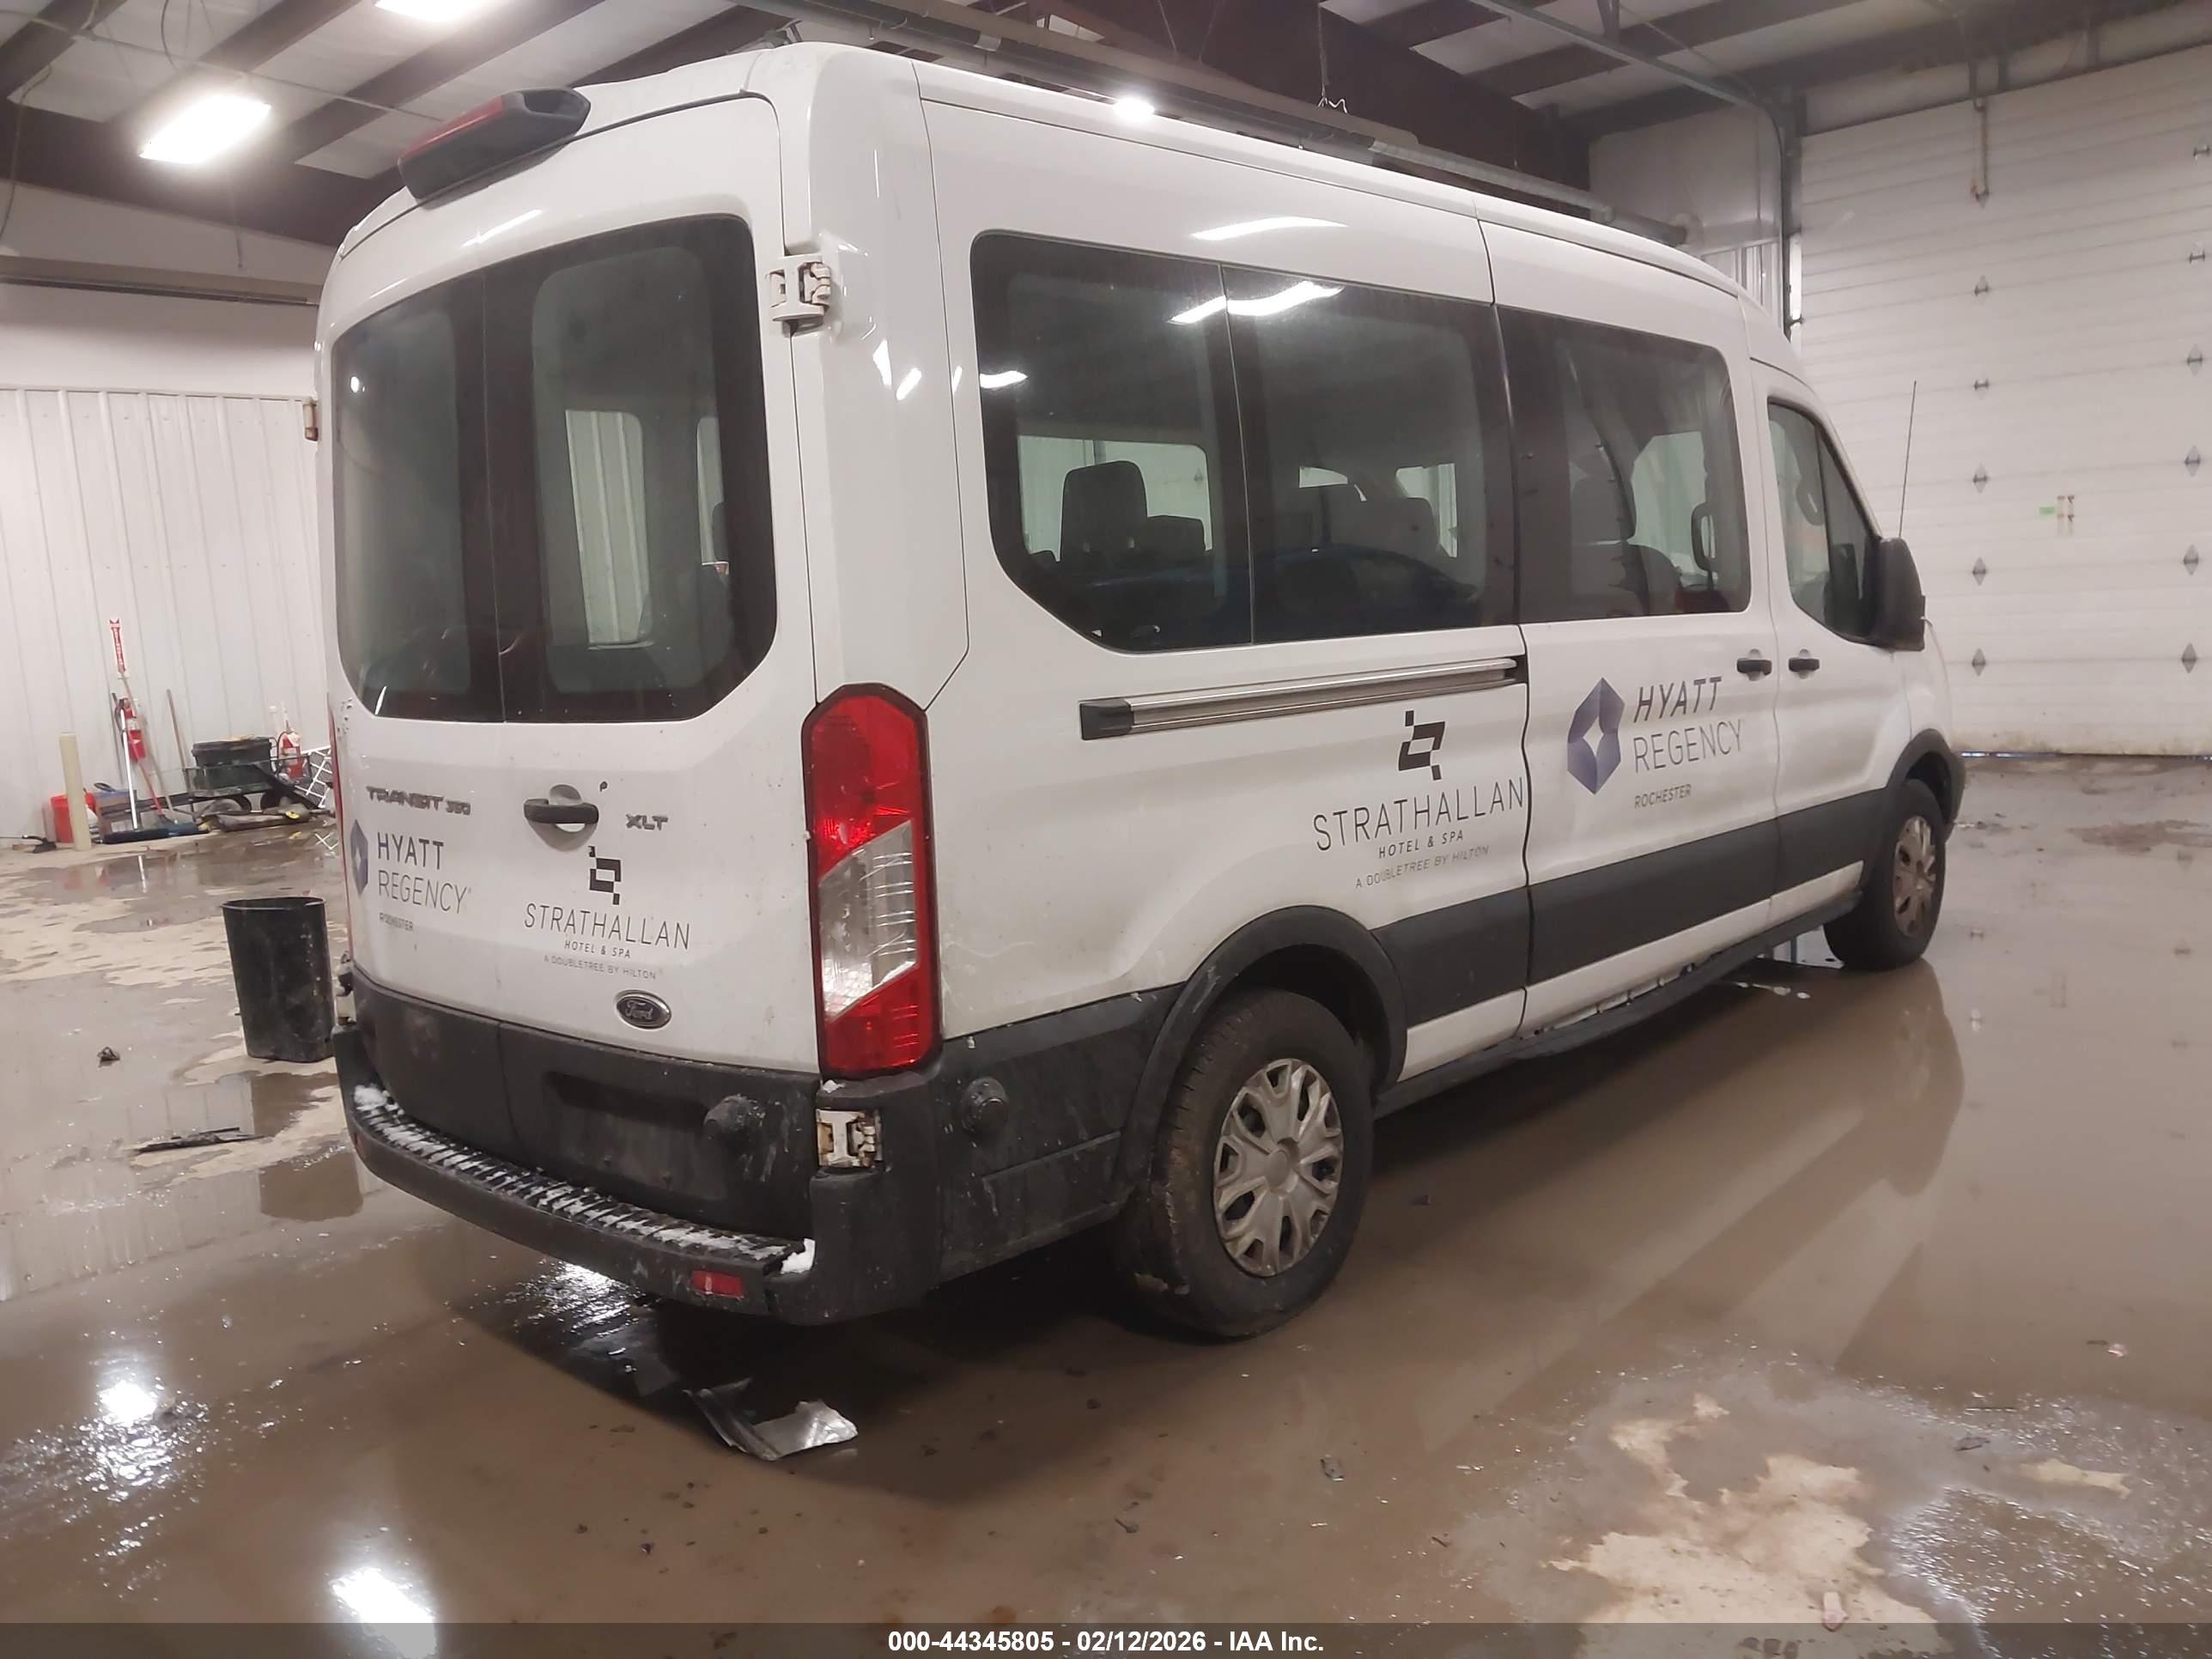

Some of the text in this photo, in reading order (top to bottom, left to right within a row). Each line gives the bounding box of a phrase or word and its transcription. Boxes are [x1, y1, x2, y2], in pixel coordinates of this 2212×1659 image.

[1633, 676, 1723, 723] HYATT
[1632, 719, 1742, 773] REGENCY
[365, 785, 445, 811] TRANSIT
[1313, 776, 1524, 851] STRATHALLAN
[1634, 783, 1692, 809] ROCHESTER
[625, 813, 668, 831] XLT
[377, 831, 445, 871] HYATT
[1378, 830, 1464, 860] HOTEL & SPA
[1355, 845, 1490, 889] A DOUBLETREE BY HILTON
[378, 870, 468, 915] REGENCY
[523, 903, 690, 951] STRATHALLAN
[564, 940, 631, 959] HOTEL & SPA
[543, 954, 656, 981] A DOUBLETREE BY HILTON
[624, 1000, 653, 1020] Ford
